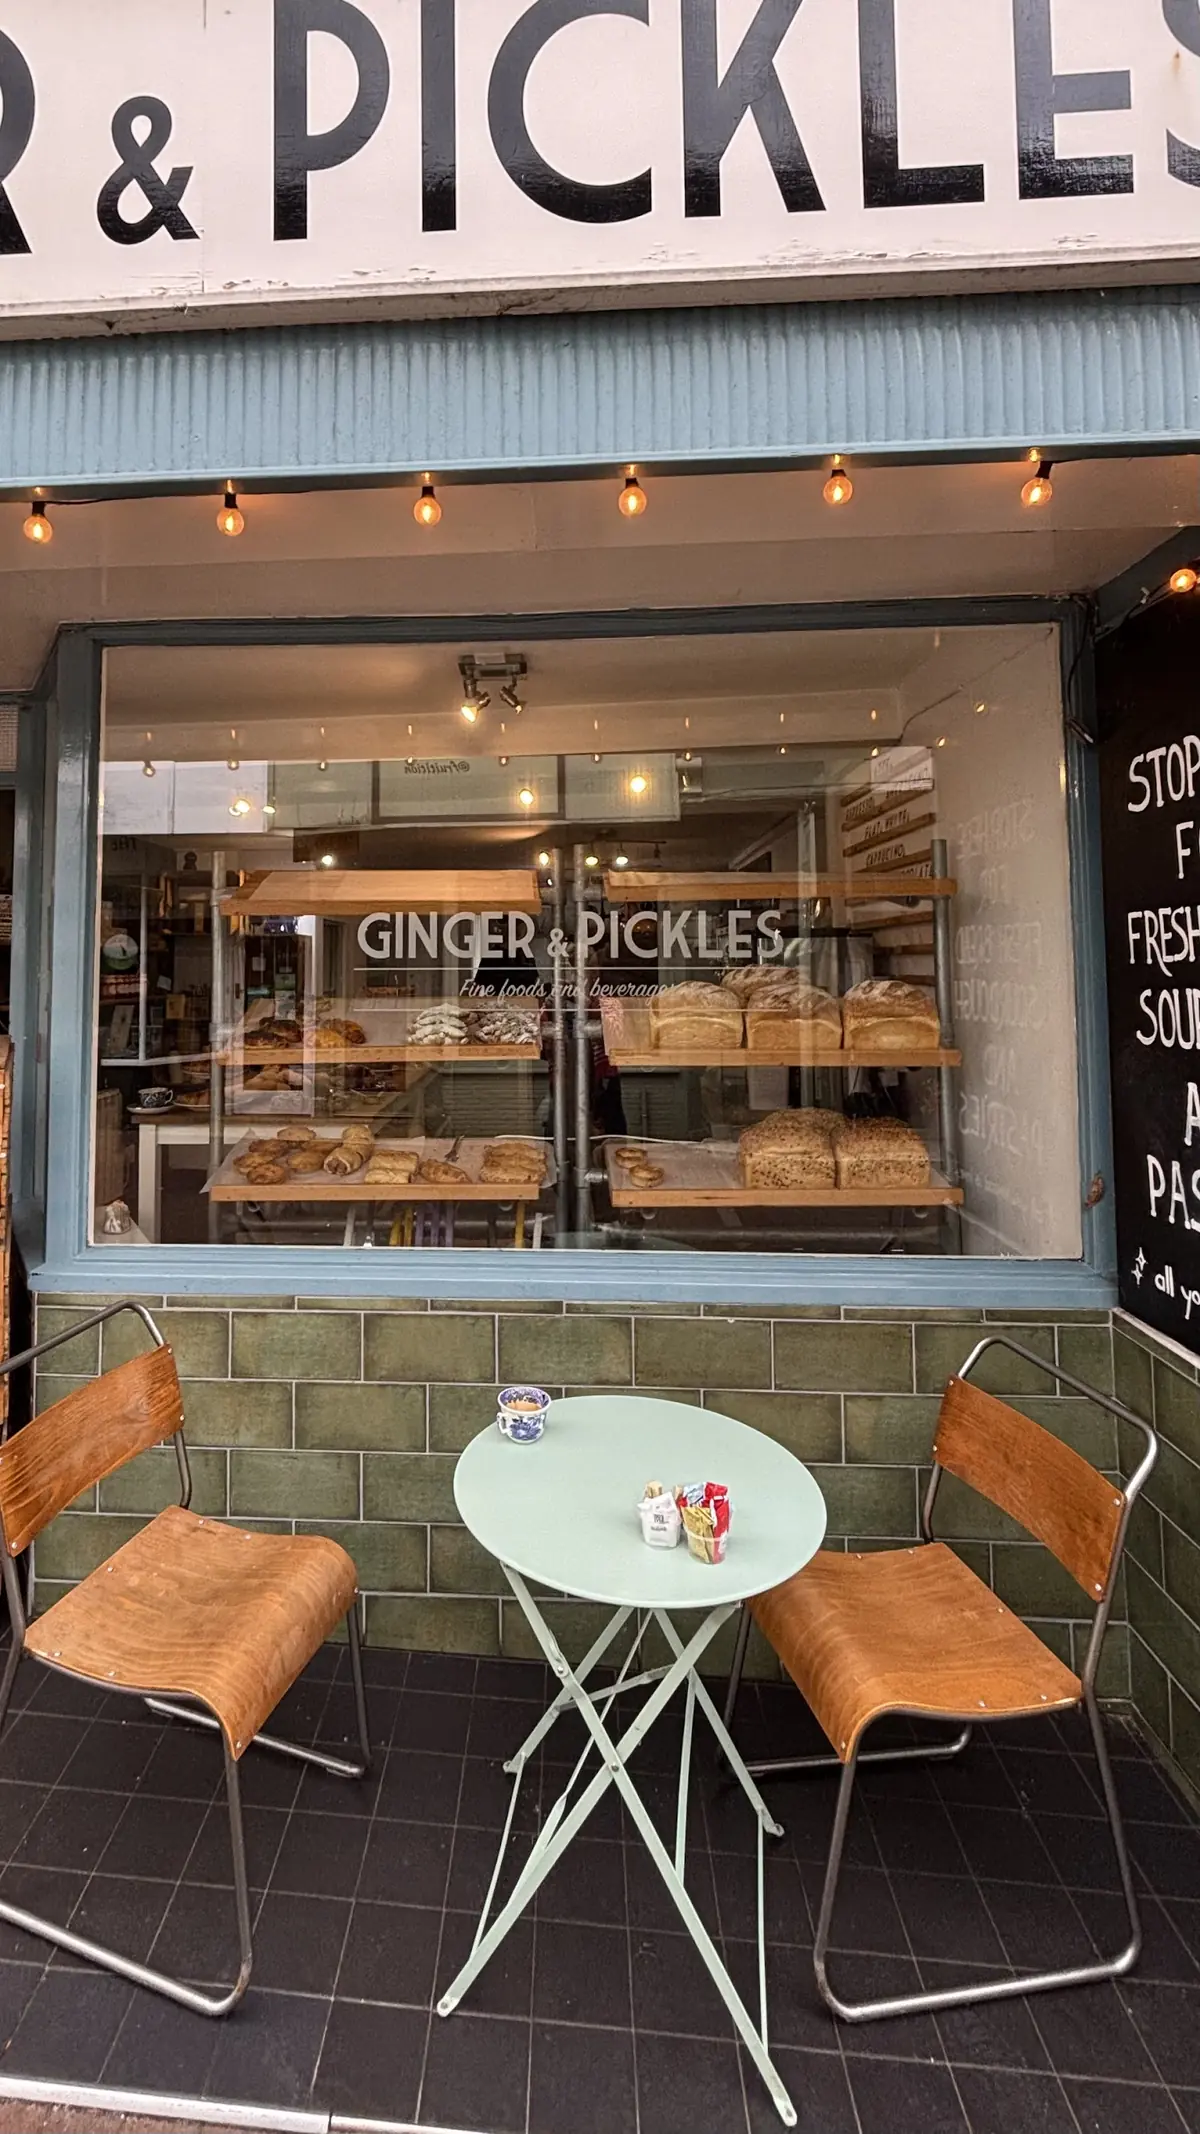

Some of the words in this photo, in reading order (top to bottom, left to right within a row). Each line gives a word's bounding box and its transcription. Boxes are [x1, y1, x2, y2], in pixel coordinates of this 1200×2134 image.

[96, 95, 201, 245] &
[357, 910, 536, 960] GINGER
[547, 926, 571, 958] &
[576, 909, 785, 960] PICKLES
[459, 978, 496, 998] Fine
[496, 977, 548, 1005] foods
[589, 976, 677, 1008] beverage
[1154, 1264, 1174, 1298] all
